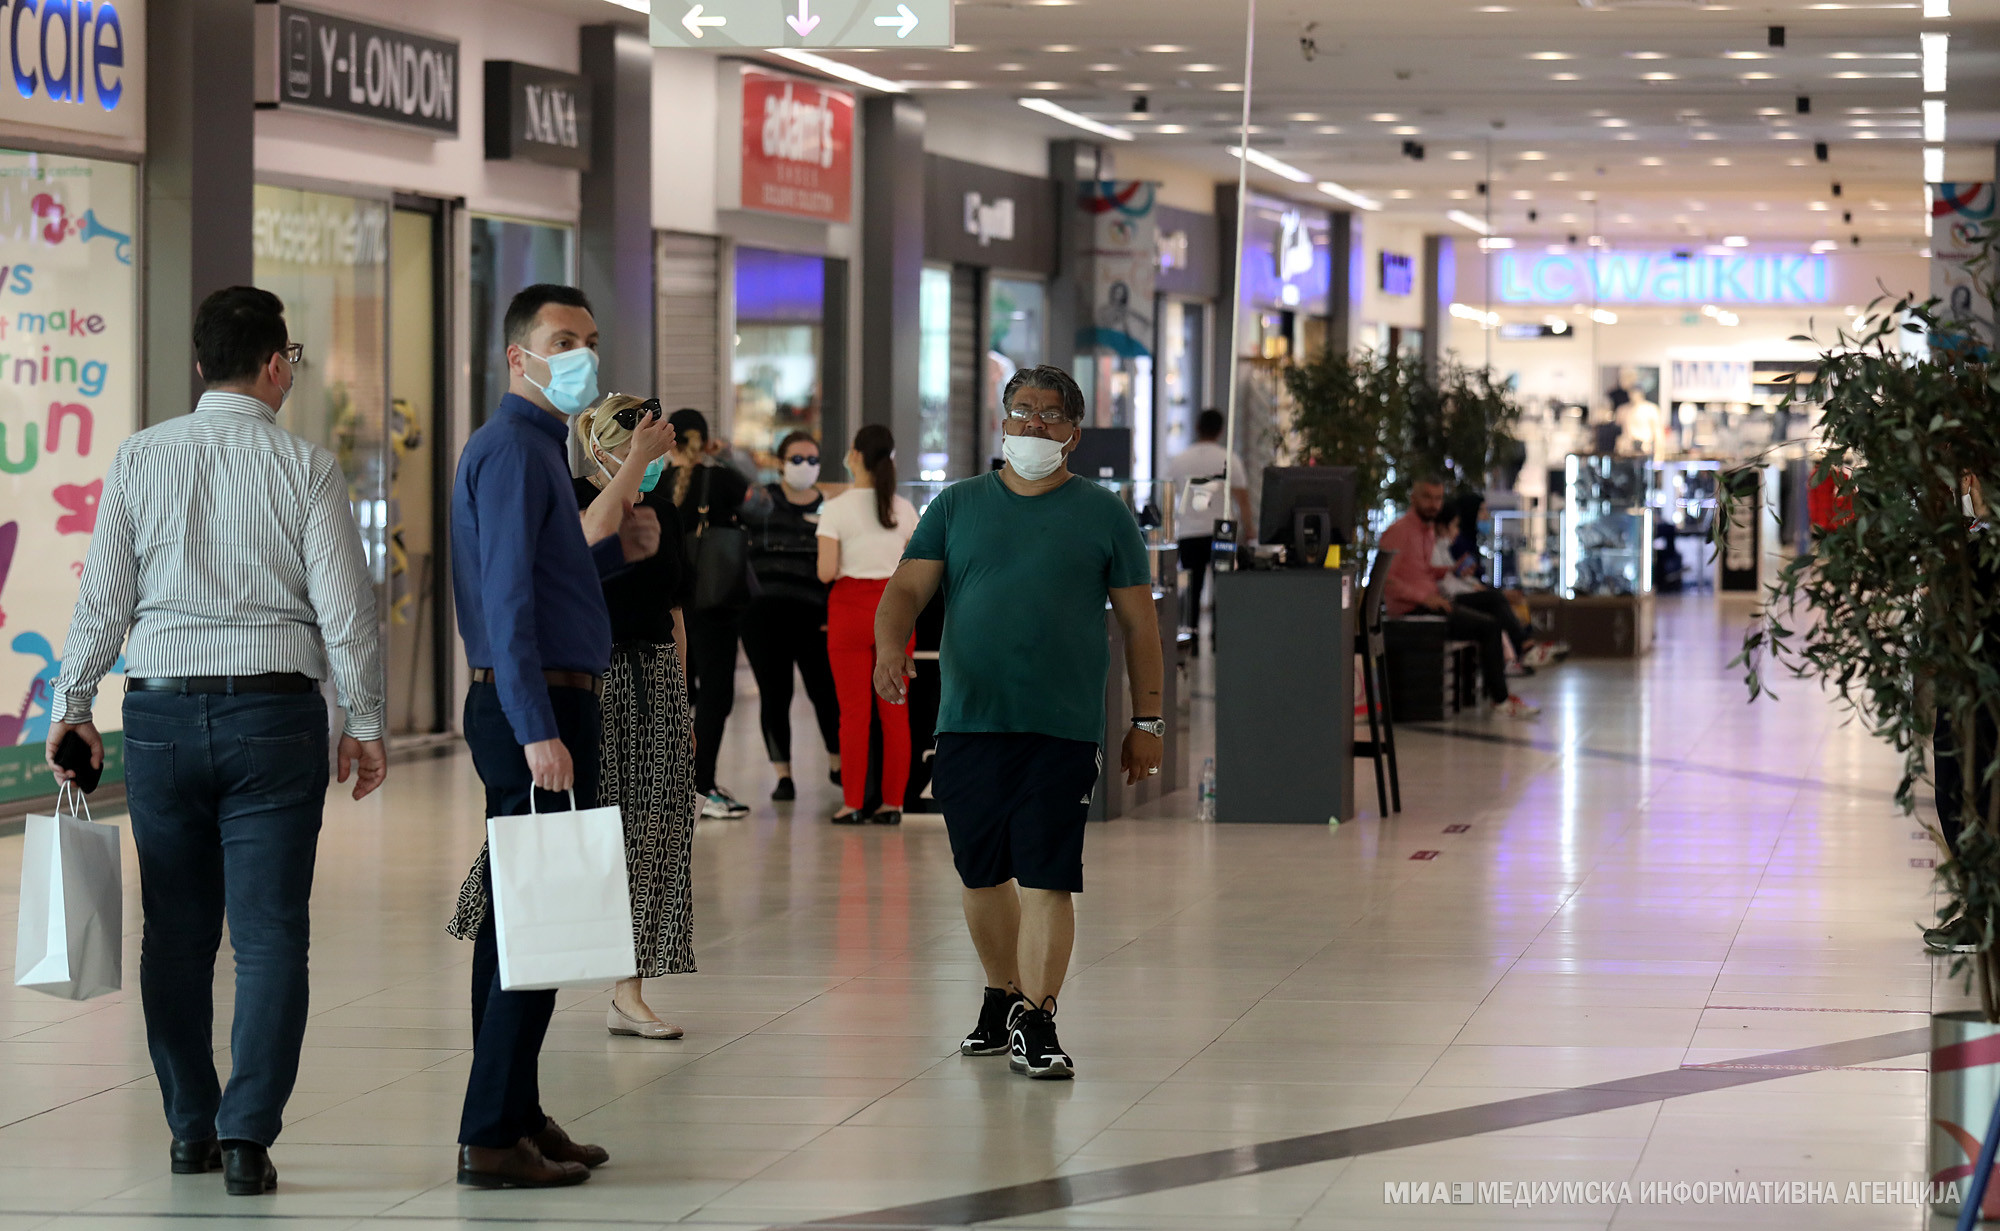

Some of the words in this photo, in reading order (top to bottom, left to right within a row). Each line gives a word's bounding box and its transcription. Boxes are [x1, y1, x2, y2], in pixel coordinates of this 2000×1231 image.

[0, 0, 124, 112] care
[318, 25, 454, 122] Y-LONDON
[524, 84, 578, 149] NANA
[1501, 254, 1576, 302] LC
[17, 309, 106, 337] make
